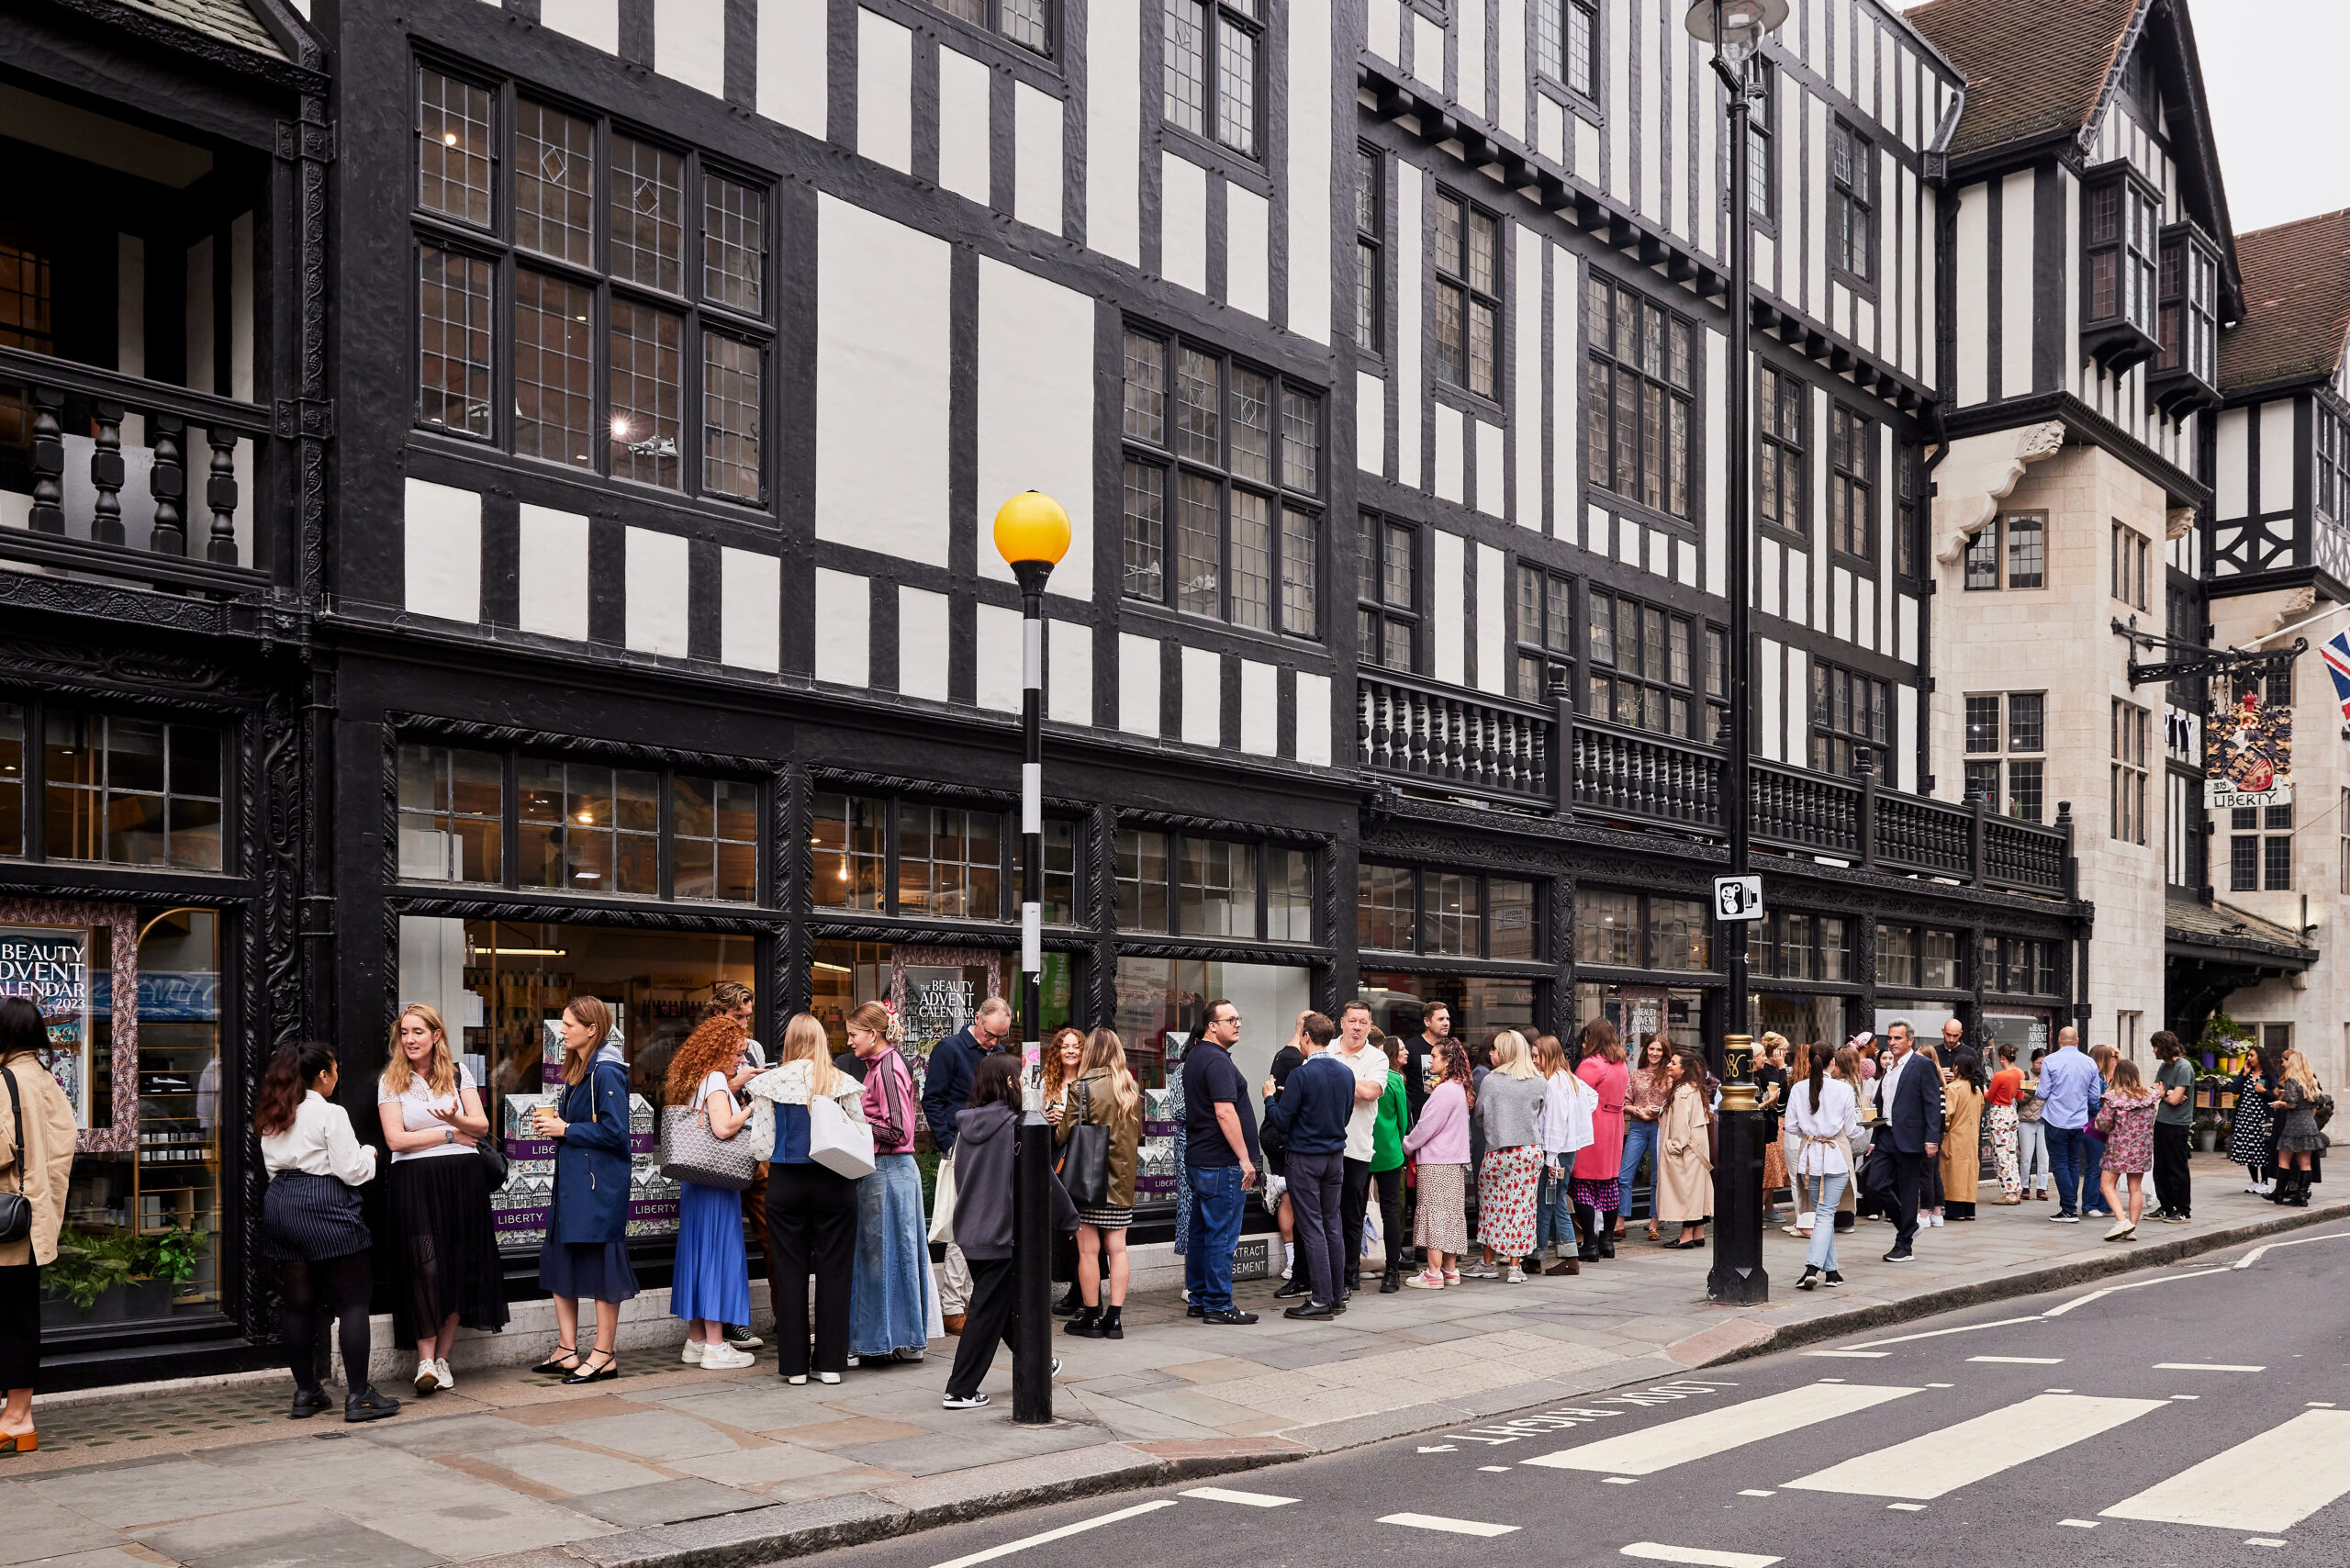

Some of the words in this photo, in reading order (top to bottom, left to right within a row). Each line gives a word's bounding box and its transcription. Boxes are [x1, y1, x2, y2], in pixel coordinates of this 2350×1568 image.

[2213, 781, 2227, 790] 1875
[2, 943, 85, 962] BEAUTY
[0, 960, 85, 982] DVENT
[0, 980, 85, 998] LENDAR
[932, 980, 975, 992] BEAUTY
[55, 997, 85, 1010] 2023
[919, 991, 975, 1007] ADVENT
[918, 1005, 975, 1018] CALENDAR
[1638, 1007, 1657, 1016] BEAUTY
[1632, 1015, 1657, 1025] ADVENT
[1631, 1025, 1657, 1034] CALENDAR
[2028, 1032, 2048, 1042] ADVENT
[532, 1145, 556, 1155] LIBE
[1155, 1179, 1177, 1188] LIBERT
[498, 1212, 544, 1225] LIBERTY.
[1233, 1245, 1266, 1259] XTRACT
[1231, 1260, 1266, 1274] SEMENT
[1591, 1380, 1740, 1406] LOOK
[1443, 1407, 1627, 1446] RIGHT
